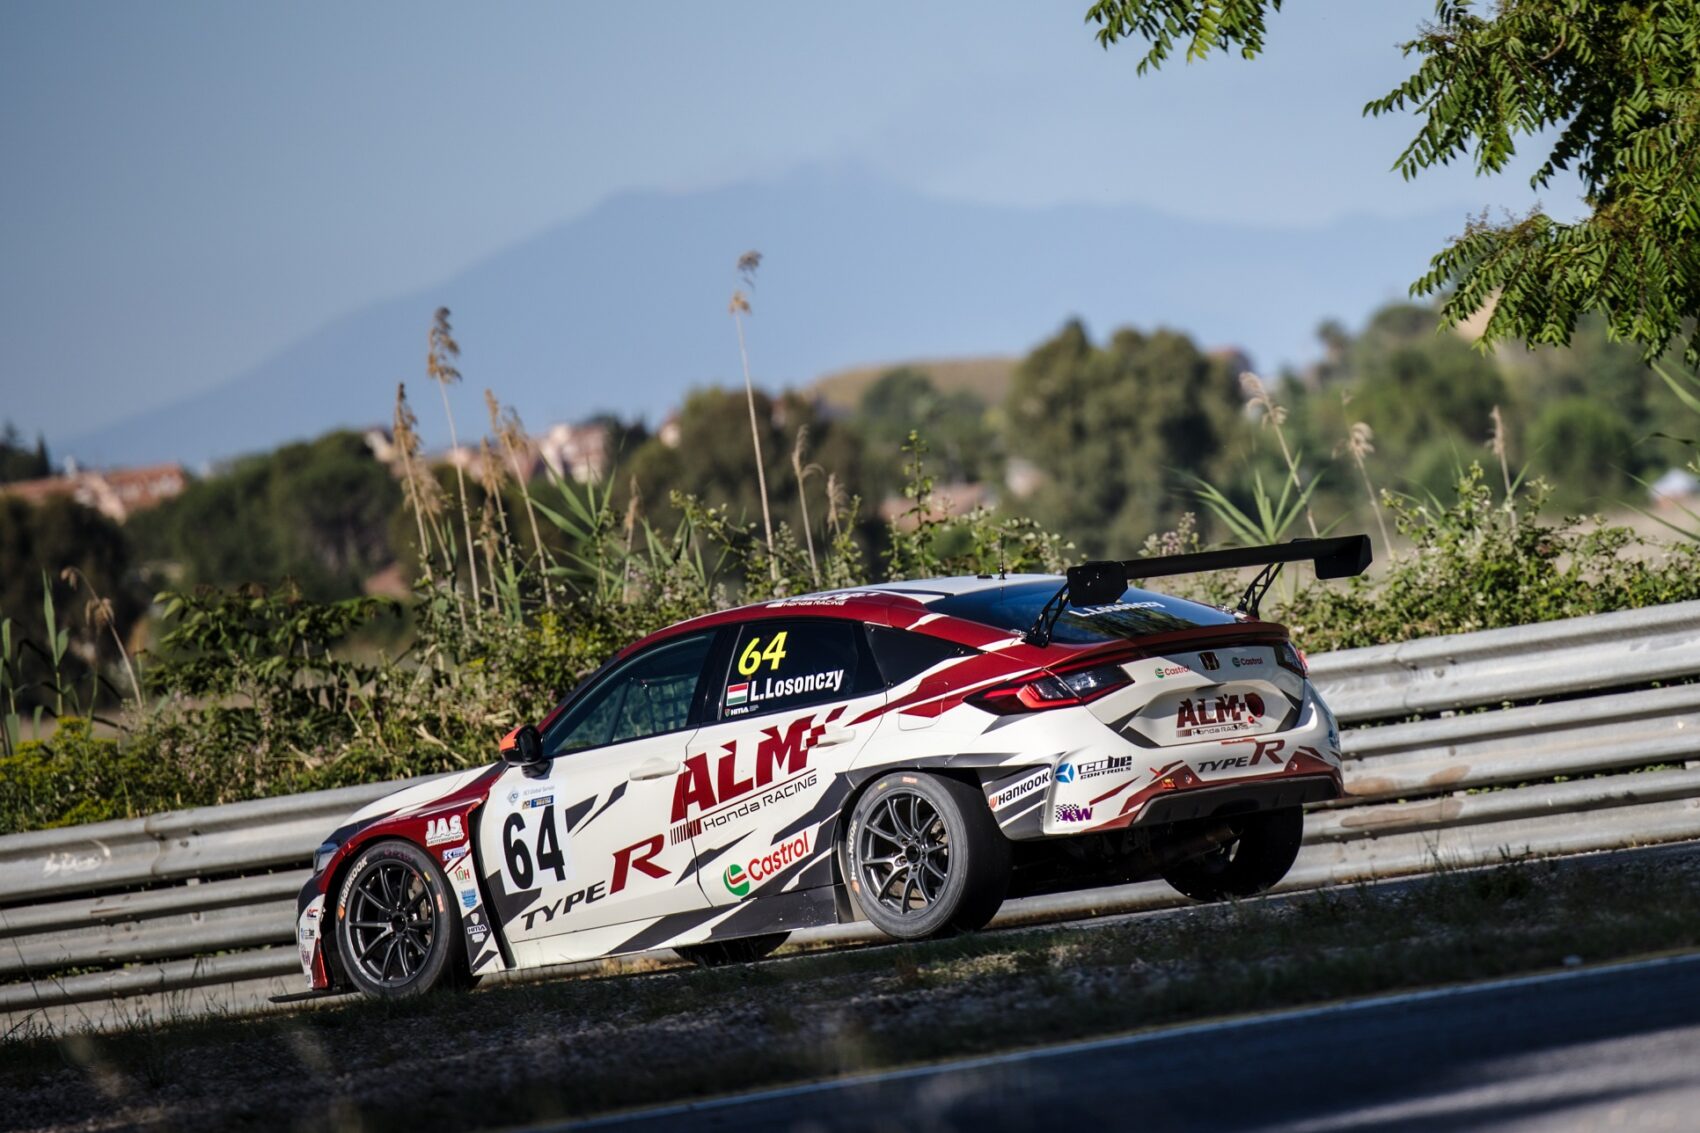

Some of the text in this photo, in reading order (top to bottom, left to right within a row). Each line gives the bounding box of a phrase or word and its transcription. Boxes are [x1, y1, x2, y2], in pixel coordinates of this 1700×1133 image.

[738, 631, 788, 676] 64
[1164, 665, 1191, 676] Castrol
[1240, 656, 1264, 666] Castrol
[750, 669, 844, 702] L.Losonczy
[671, 712, 824, 824] ALM
[1080, 766, 1131, 780] CONTROLS
[1198, 739, 1286, 773] TYPE R
[703, 774, 817, 831] Honda RACING
[1060, 806, 1093, 822] KW
[426, 815, 462, 839] JAS
[503, 805, 566, 890] 64
[748, 831, 809, 881] Castrol
[521, 834, 672, 931] TYPE R
